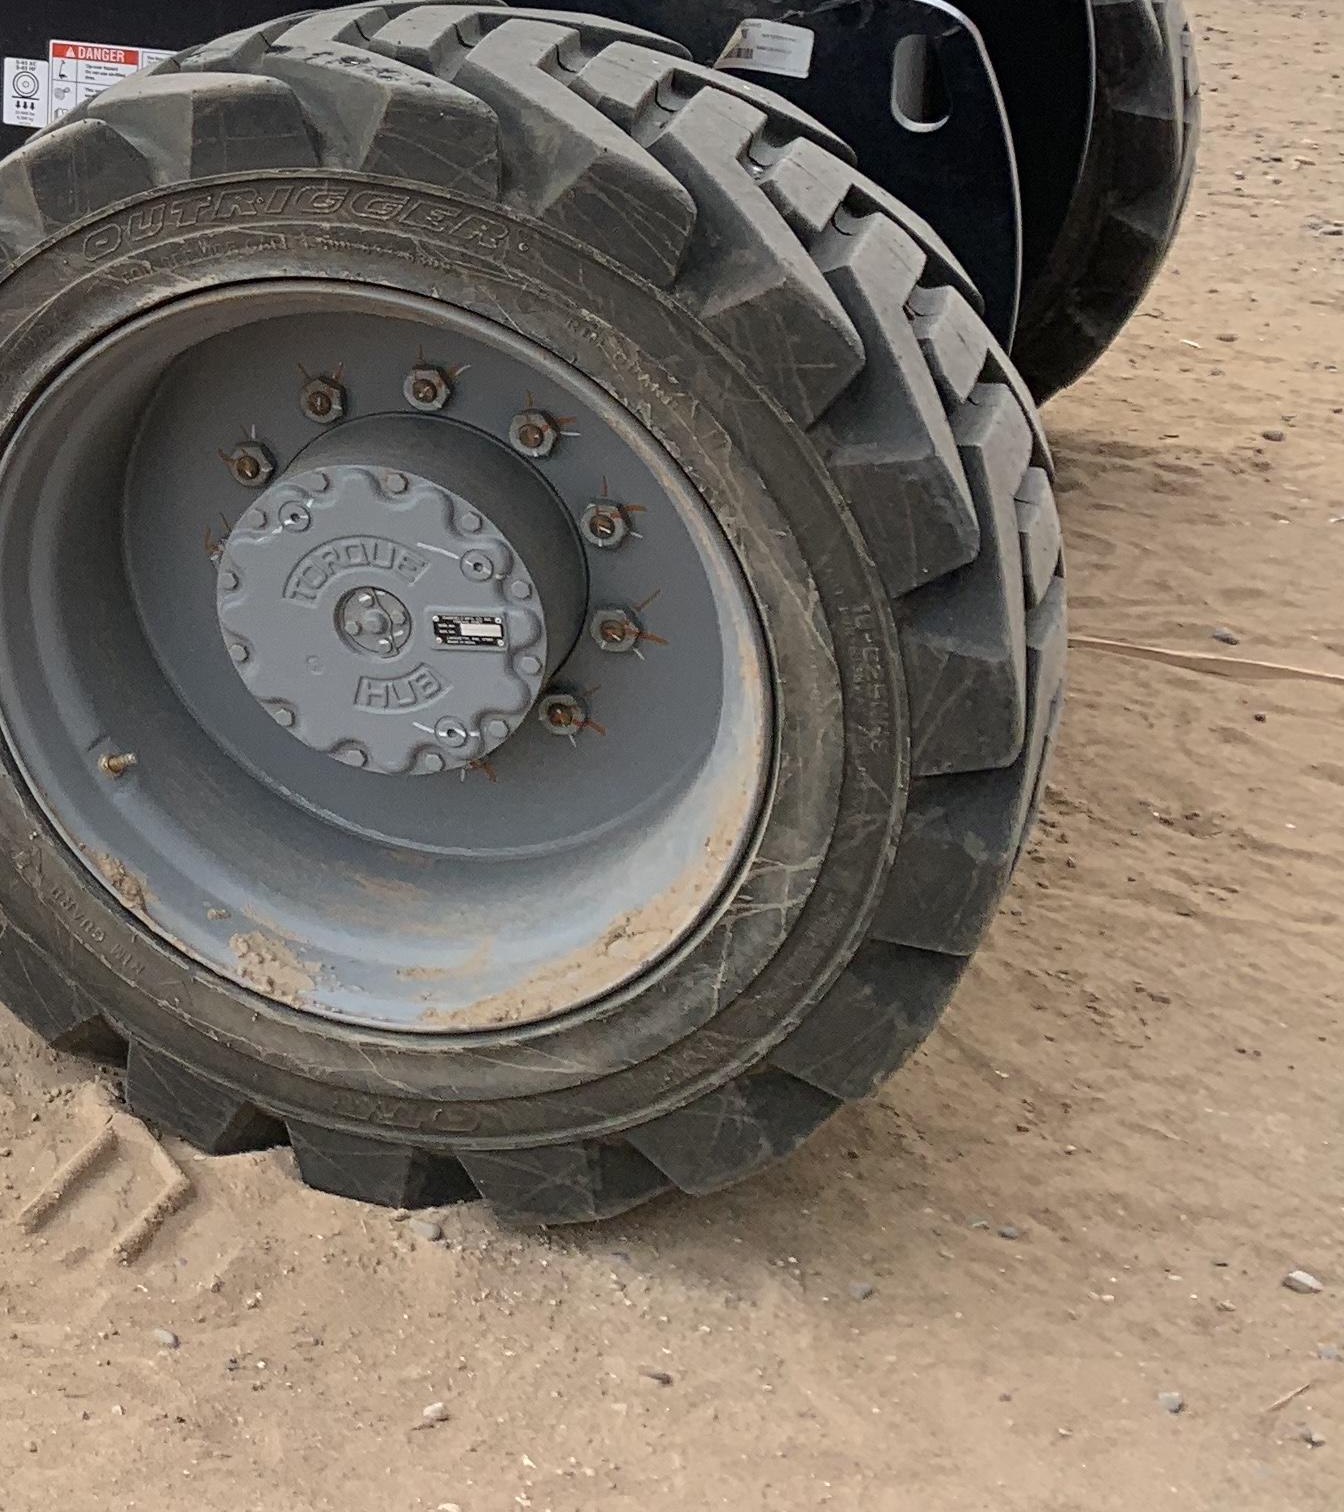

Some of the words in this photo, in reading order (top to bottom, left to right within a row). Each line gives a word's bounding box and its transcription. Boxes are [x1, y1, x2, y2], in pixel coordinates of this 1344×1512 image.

[78, 46, 125, 63] DANGER
[83, 186, 509, 262] OUTRIGGER
[290, 541, 430, 601] TORQUE
[365, 666, 444, 708] HUB
[49, 887, 106, 943] GUARD
